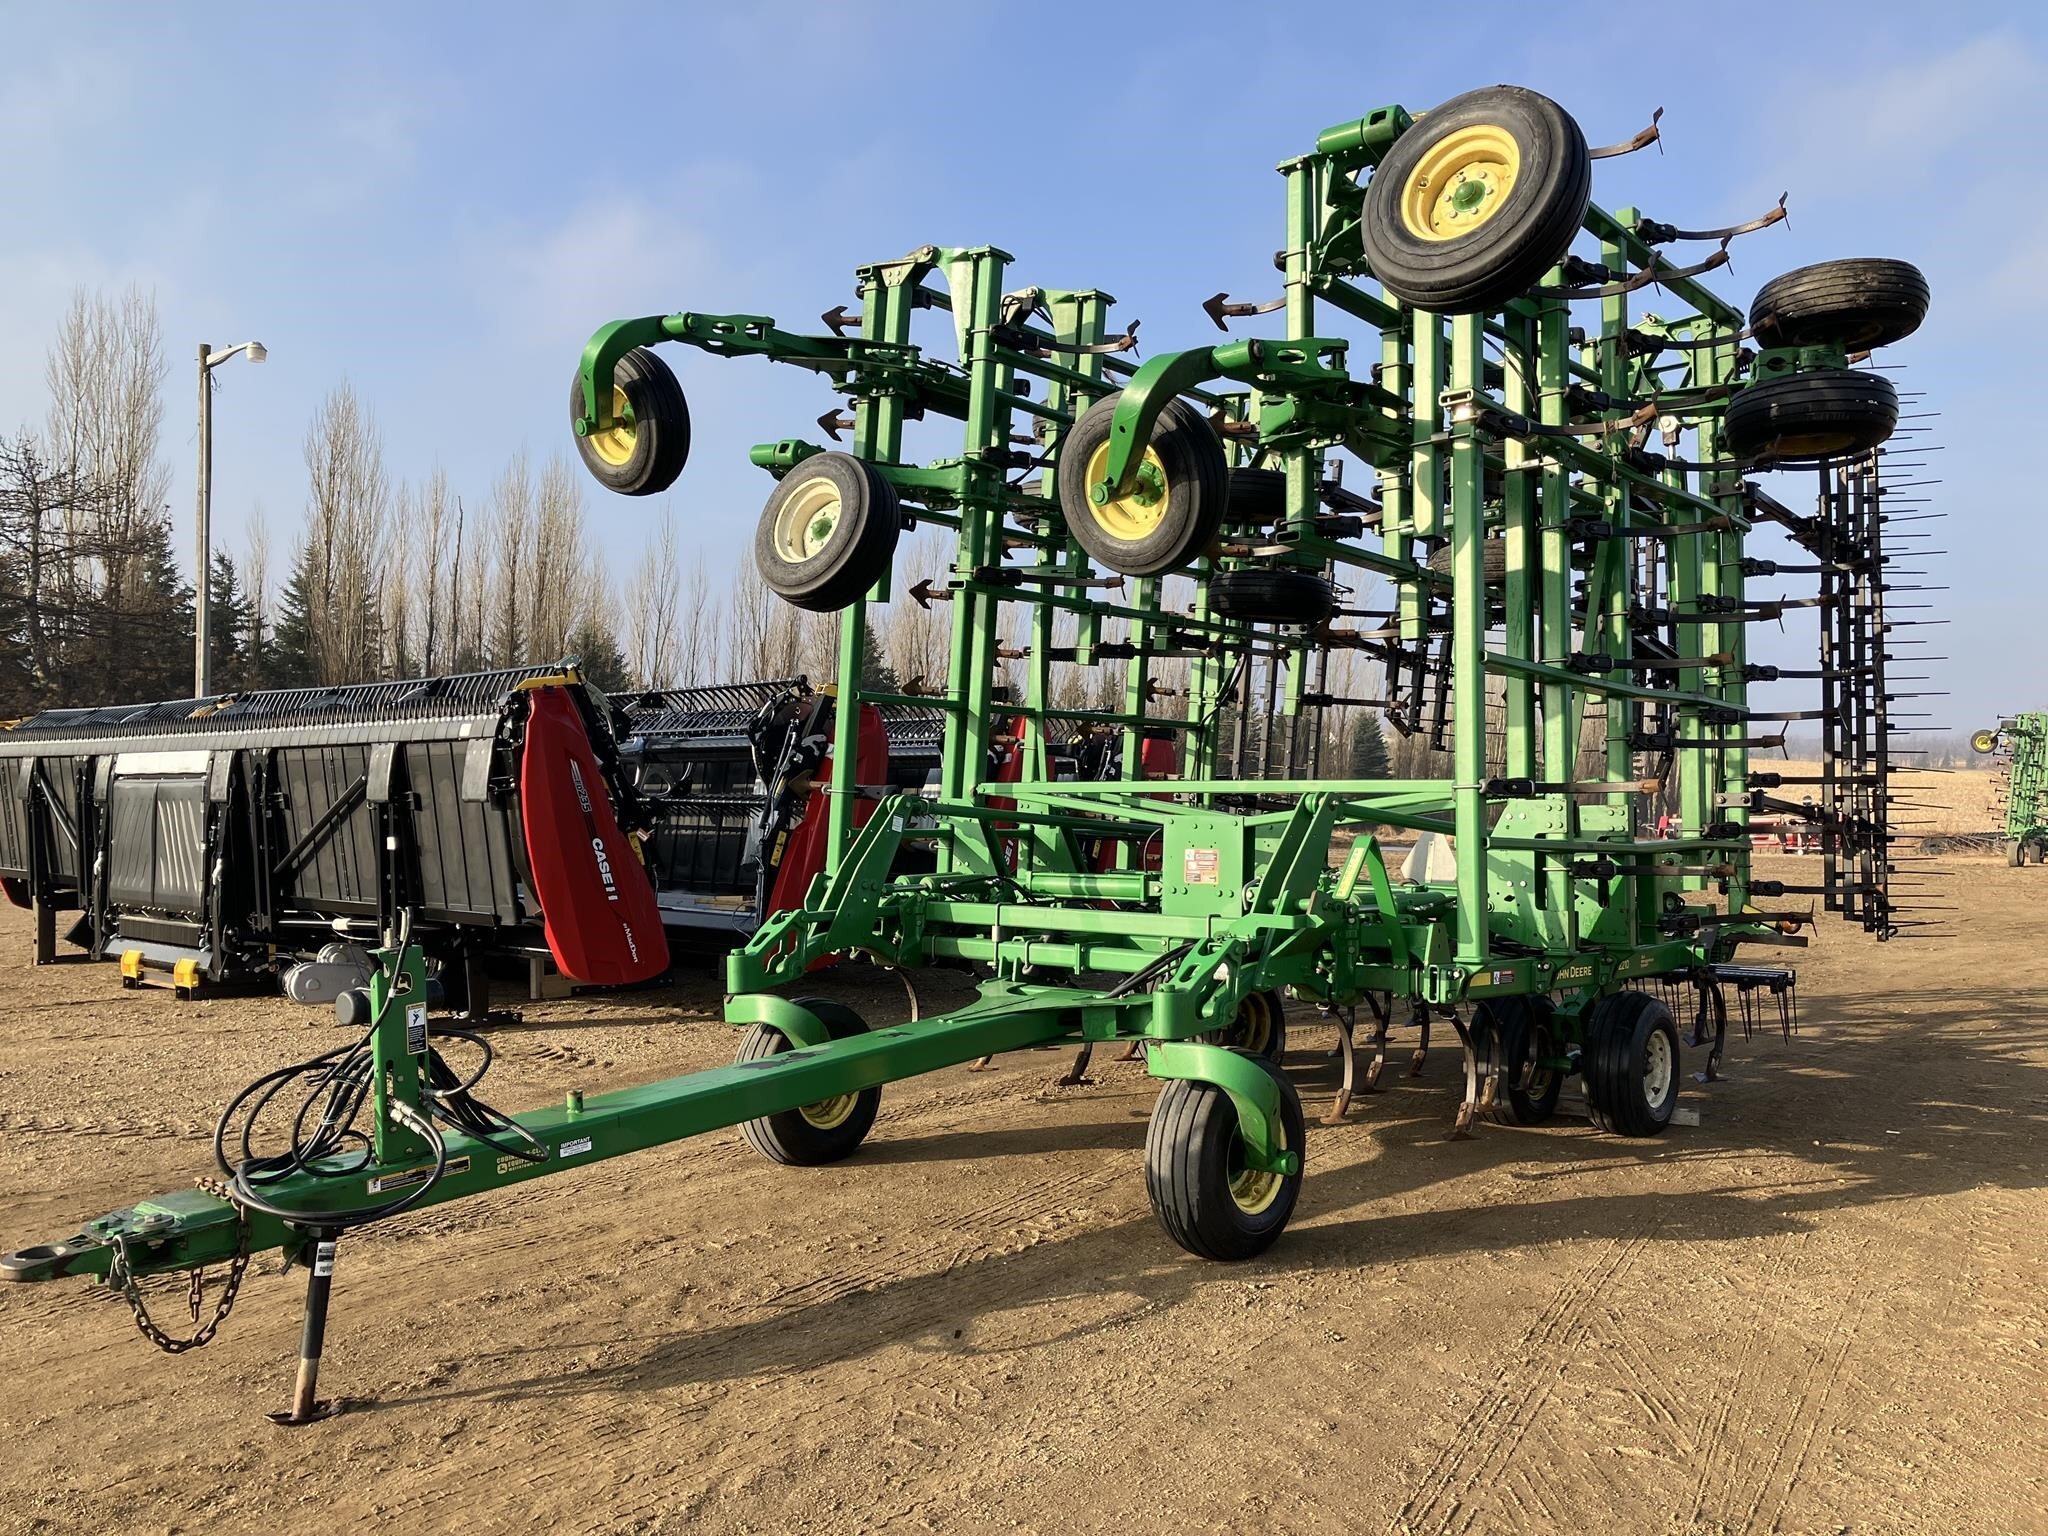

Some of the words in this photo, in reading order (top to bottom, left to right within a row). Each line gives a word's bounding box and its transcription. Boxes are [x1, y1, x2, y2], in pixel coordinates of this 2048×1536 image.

[592, 838, 613, 884] CASE
[624, 928, 638, 963] MacDon
[1570, 966, 1592, 978] DEERE
[561, 1136, 591, 1148] IMPORTANT
